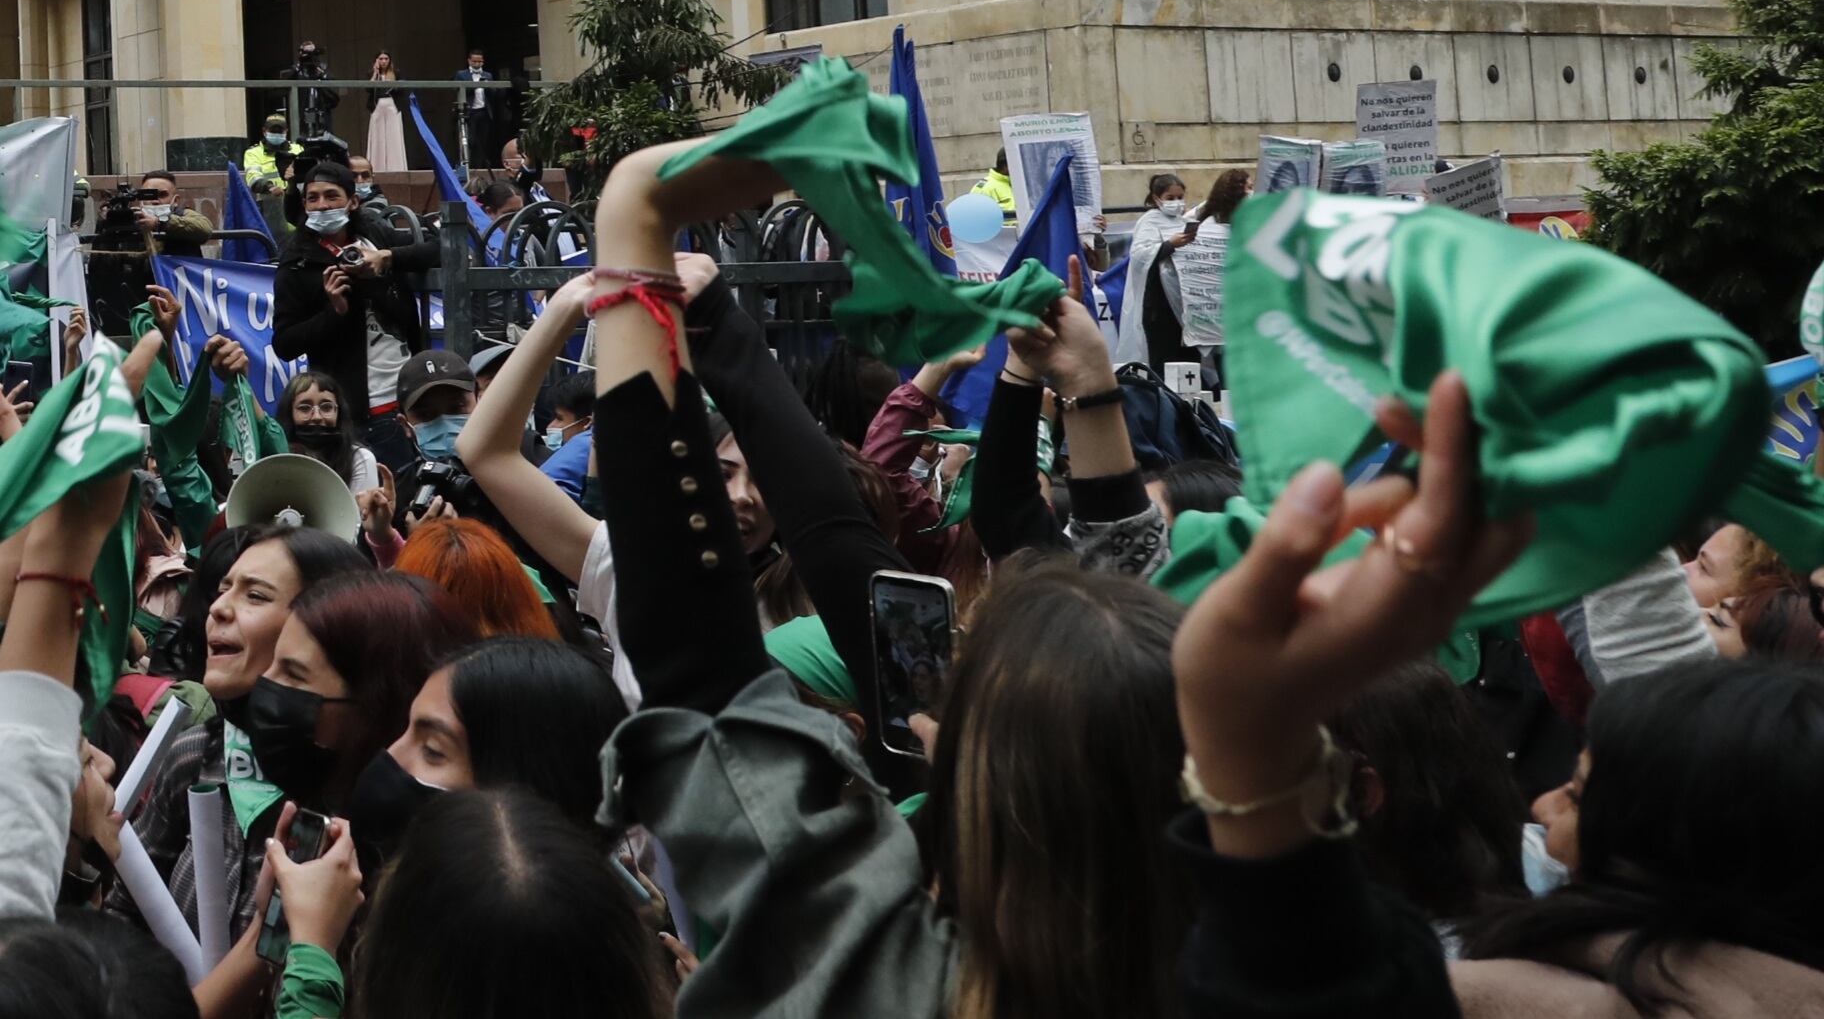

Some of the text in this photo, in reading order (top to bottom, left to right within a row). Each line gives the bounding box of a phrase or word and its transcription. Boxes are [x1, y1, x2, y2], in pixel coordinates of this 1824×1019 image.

[1360, 93, 1433, 106] No nos quieren
[1371, 107, 1426, 119] salvar de la
[1361, 119, 1433, 133] clandestinidad
[1391, 140, 1430, 152] quieren
[1386, 151, 1434, 164] rtas en la
[1389, 163, 1436, 177] ALIDAD
[1431, 186, 1446, 196] No
[1448, 179, 1466, 190] nos
[1445, 188, 1474, 204] salvar
[1475, 182, 1488, 192] de
[174, 266, 231, 337] Ni
